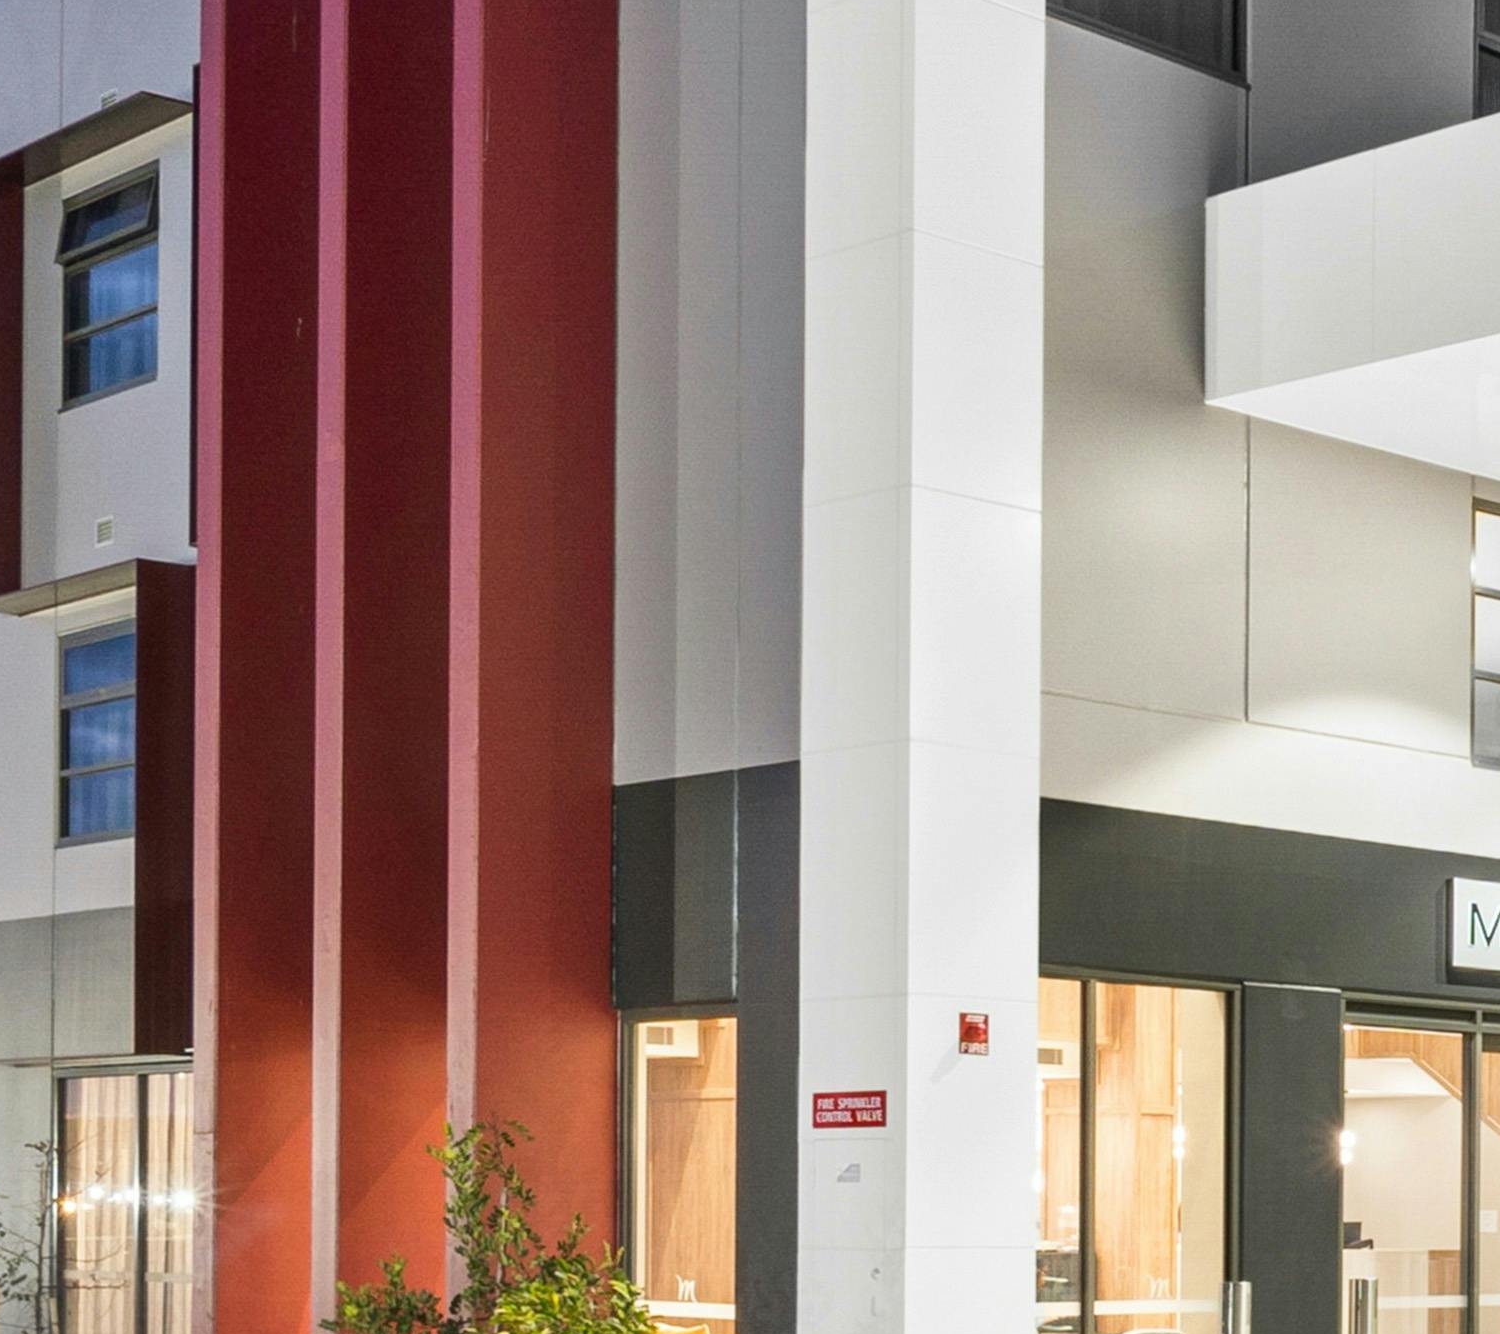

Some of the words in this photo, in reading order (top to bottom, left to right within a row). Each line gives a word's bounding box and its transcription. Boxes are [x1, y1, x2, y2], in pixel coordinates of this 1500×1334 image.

[961, 1042, 988, 1054] FIRE
[817, 1098, 835, 1109] FIRE
[838, 1097, 881, 1109] SPRINKLER
[816, 1110, 854, 1122] CONTROL
[855, 1110, 883, 1122] VALVE
